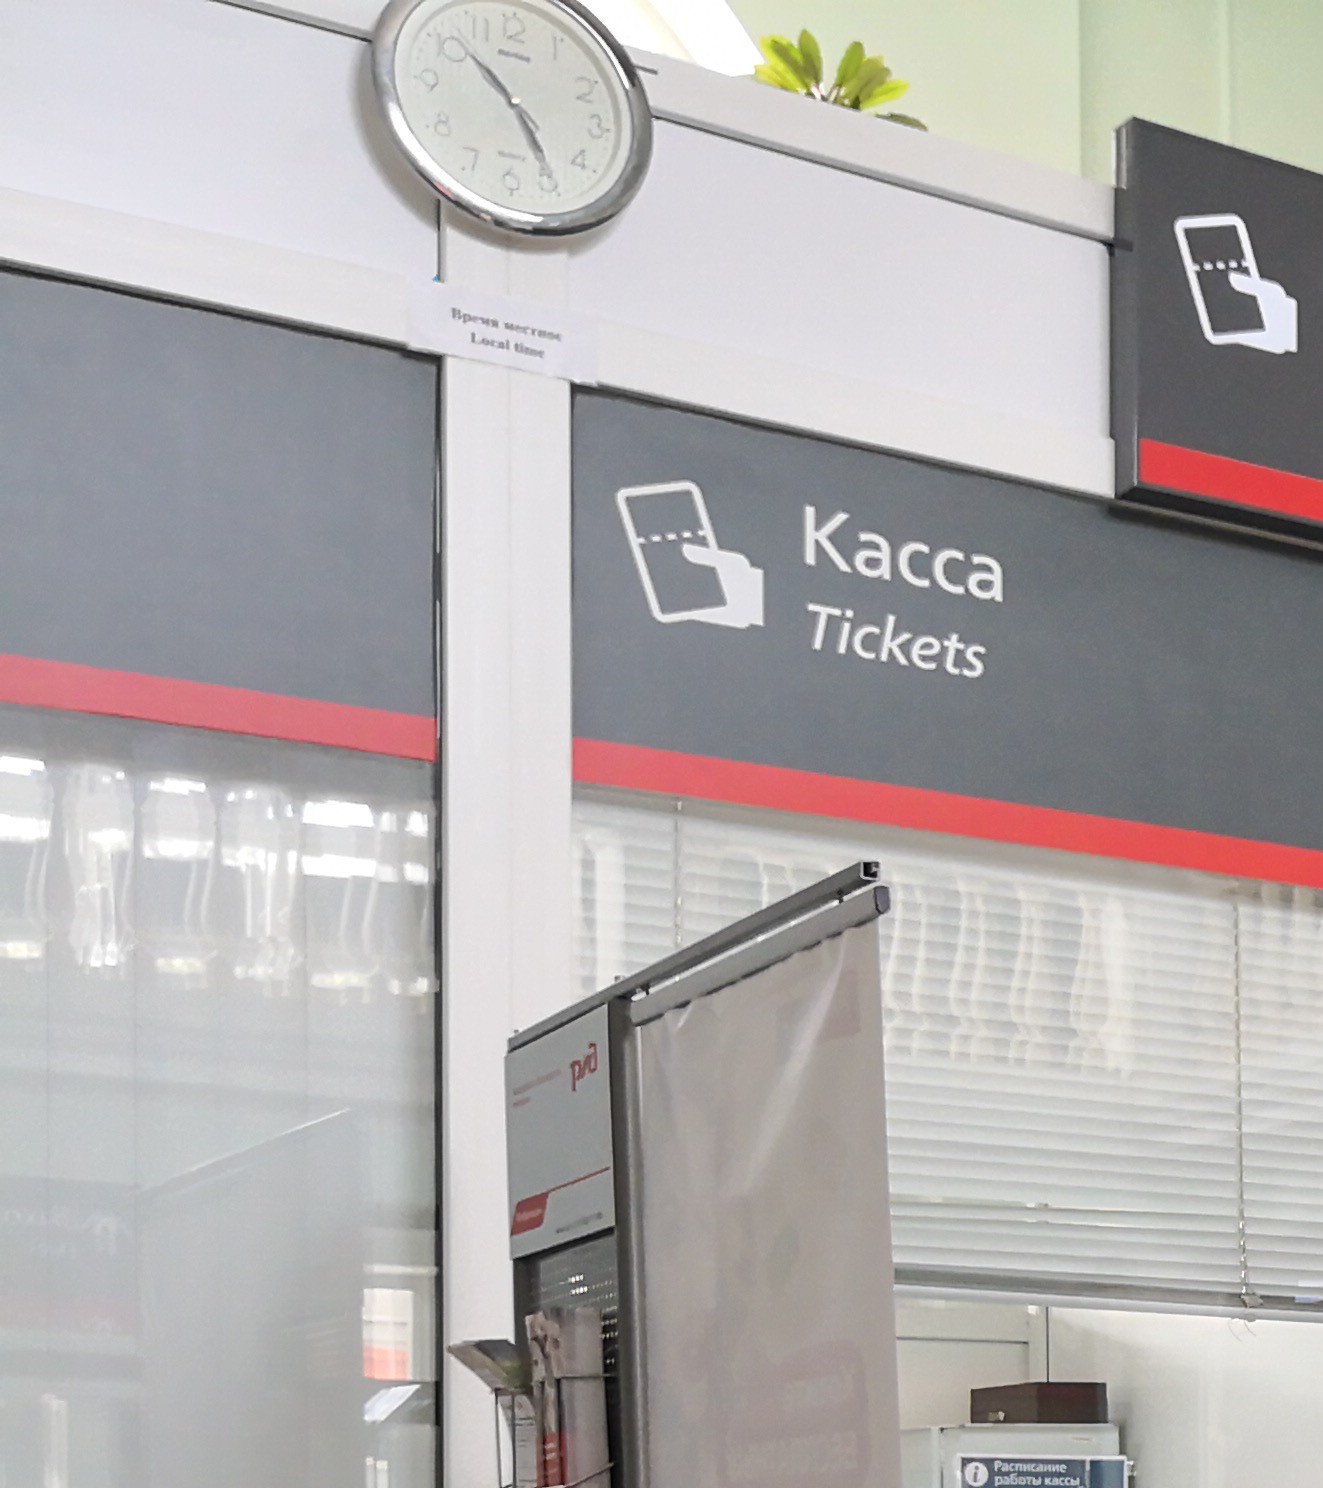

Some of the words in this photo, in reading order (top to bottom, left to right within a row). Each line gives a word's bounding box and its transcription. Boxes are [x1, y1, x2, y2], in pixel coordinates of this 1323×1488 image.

[472, 18, 489, 42] 11
[502, 15, 526, 43] 12
[419, 68, 440, 92] 9
[575, 75, 600, 103] 2
[434, 112, 451, 137] 8
[587, 113, 611, 140] 3
[462, 146, 479, 172] 7
[570, 149, 588, 171] 4
[803, 504, 1003, 603] Касса
[806, 601, 986, 678] Tickets
[994, 1460, 1067, 1474] Расписание
[994, 1474, 1042, 1487] работы
[1044, 1477, 1080, 1487] кассы
